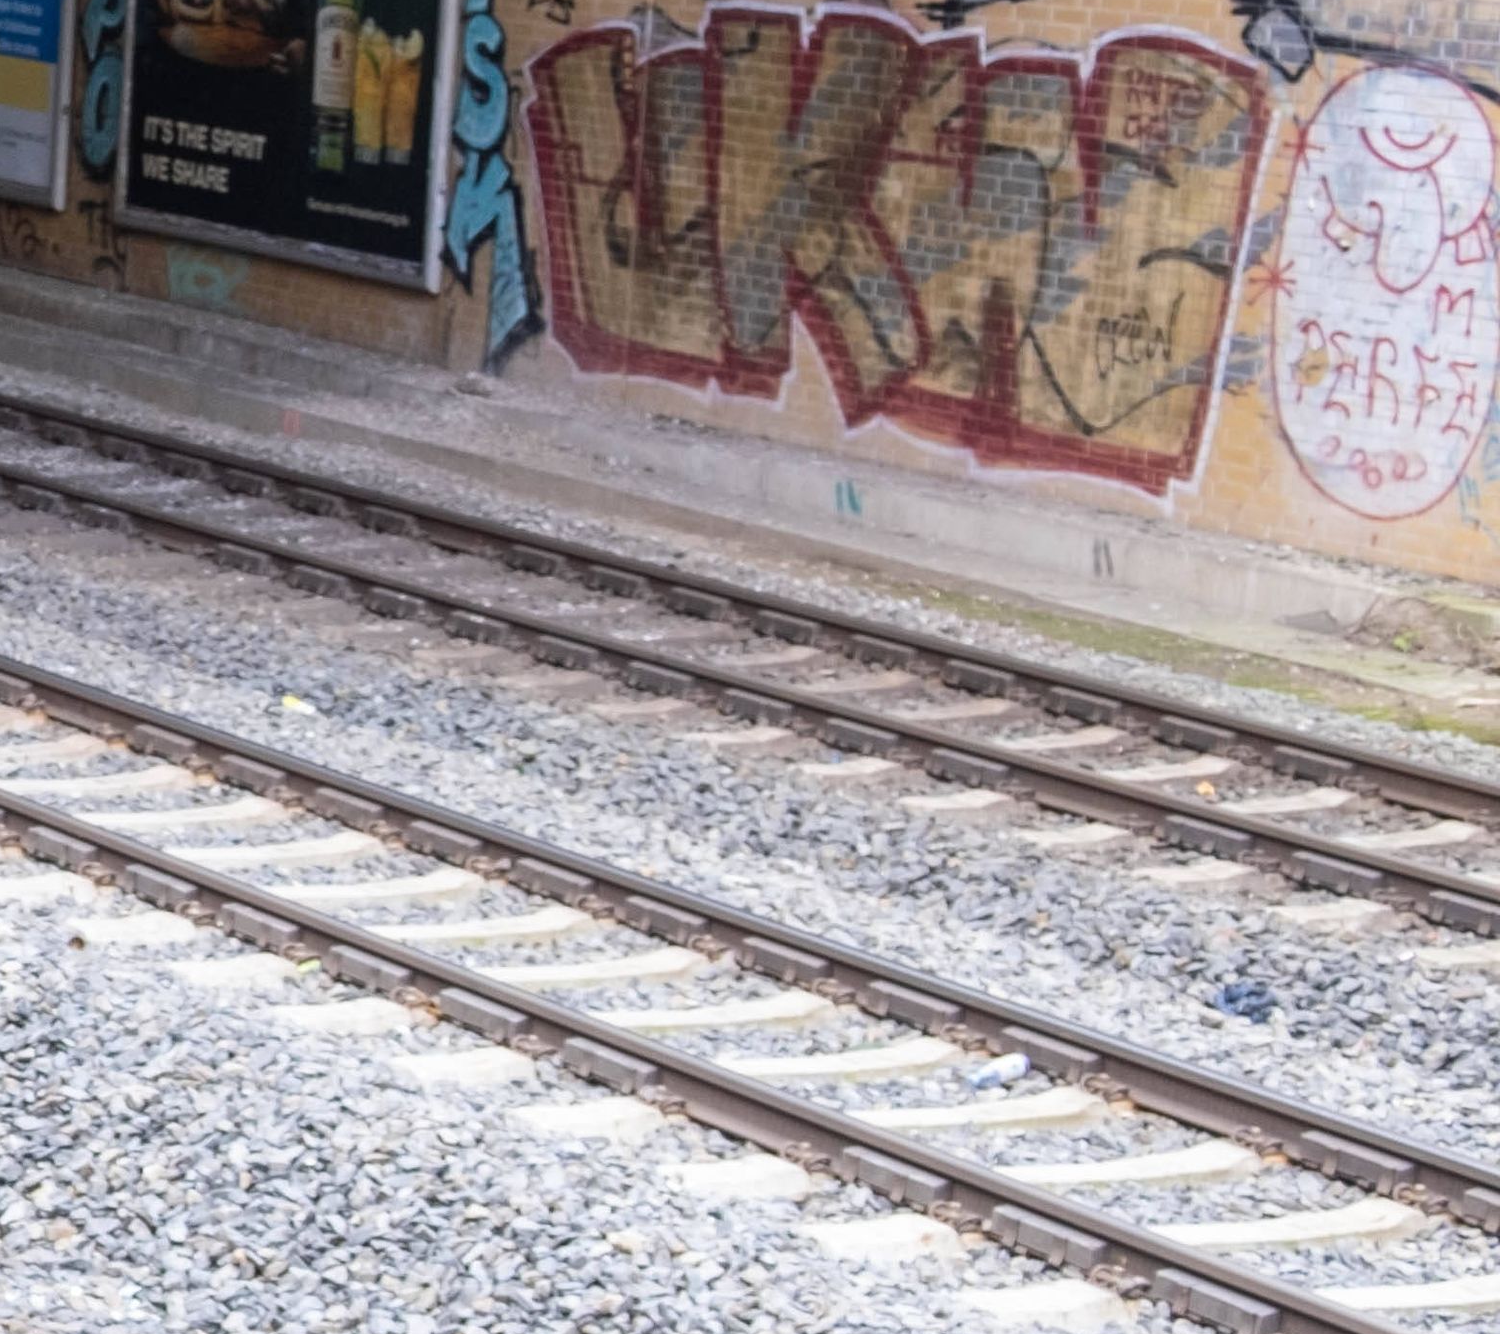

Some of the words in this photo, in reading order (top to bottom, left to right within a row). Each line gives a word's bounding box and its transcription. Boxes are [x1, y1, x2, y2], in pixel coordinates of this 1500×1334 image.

[143, 115, 175, 145] IT'S
[176, 121, 209, 151] THE
[210, 126, 268, 161] SPIRIT
[141, 152, 170, 184] WE
[171, 157, 231, 194] SHARE
